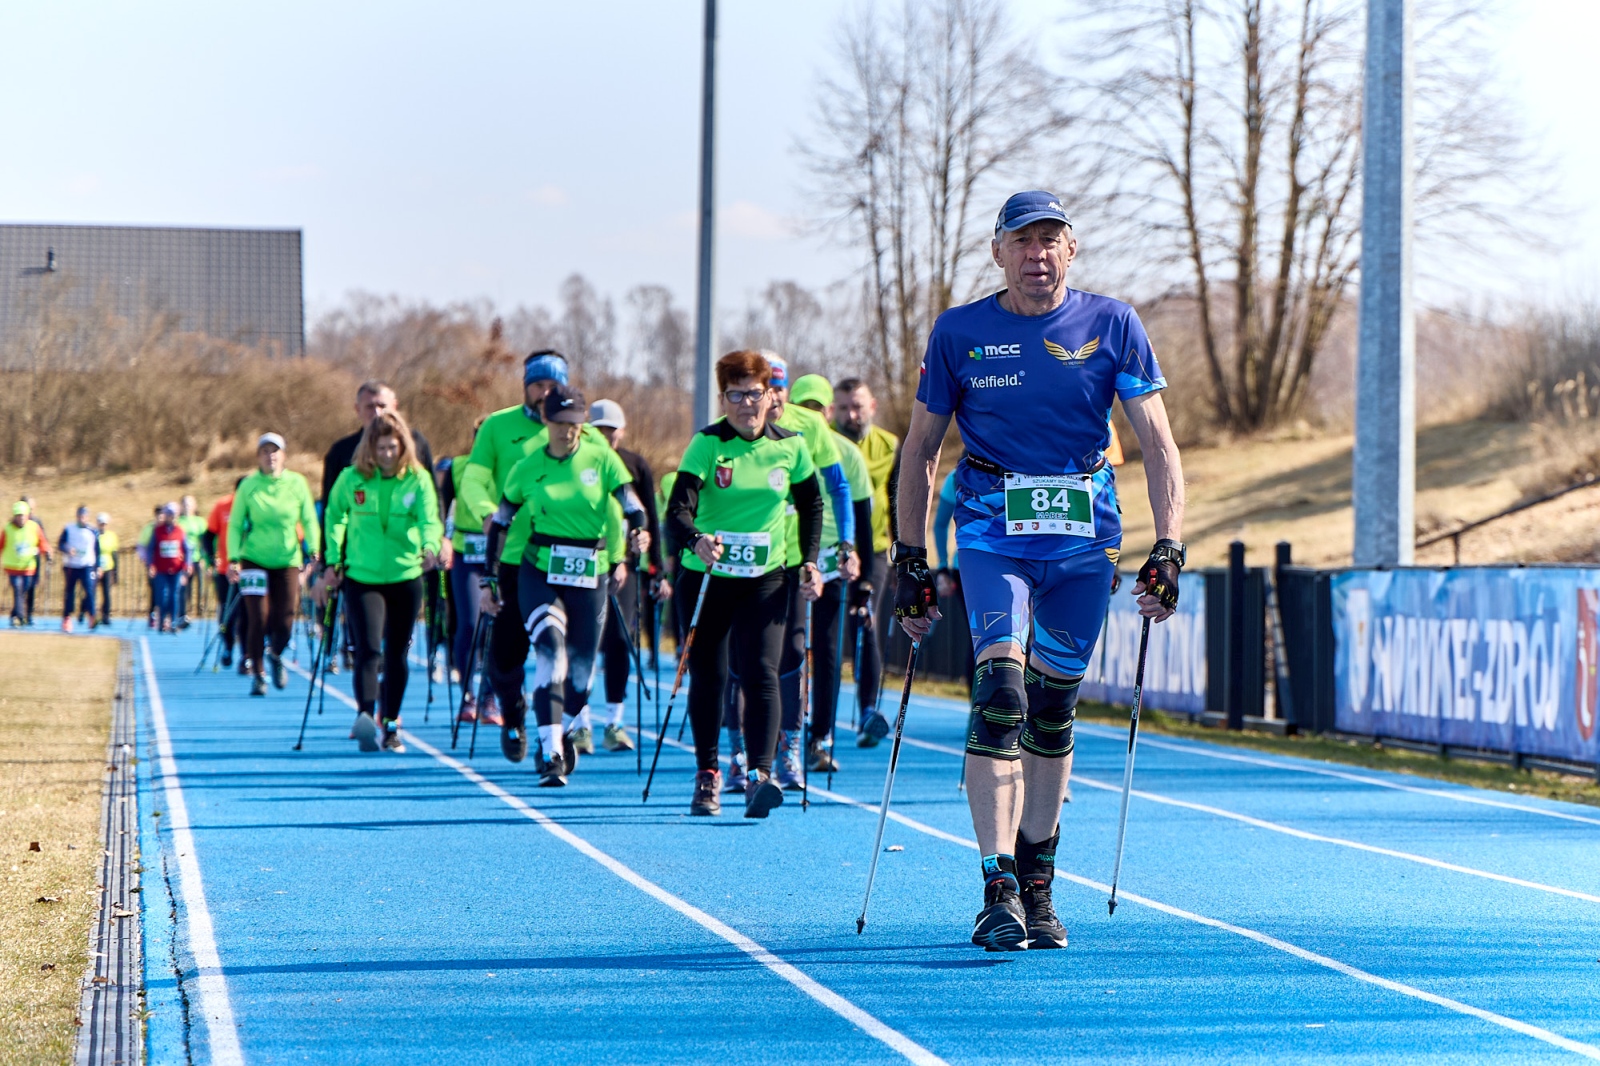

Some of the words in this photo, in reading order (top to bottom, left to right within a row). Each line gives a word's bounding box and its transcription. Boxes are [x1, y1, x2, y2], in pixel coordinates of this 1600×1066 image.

[1030, 488, 1071, 512] 84
[728, 545, 756, 562] 56
[563, 557, 586, 574] 59
